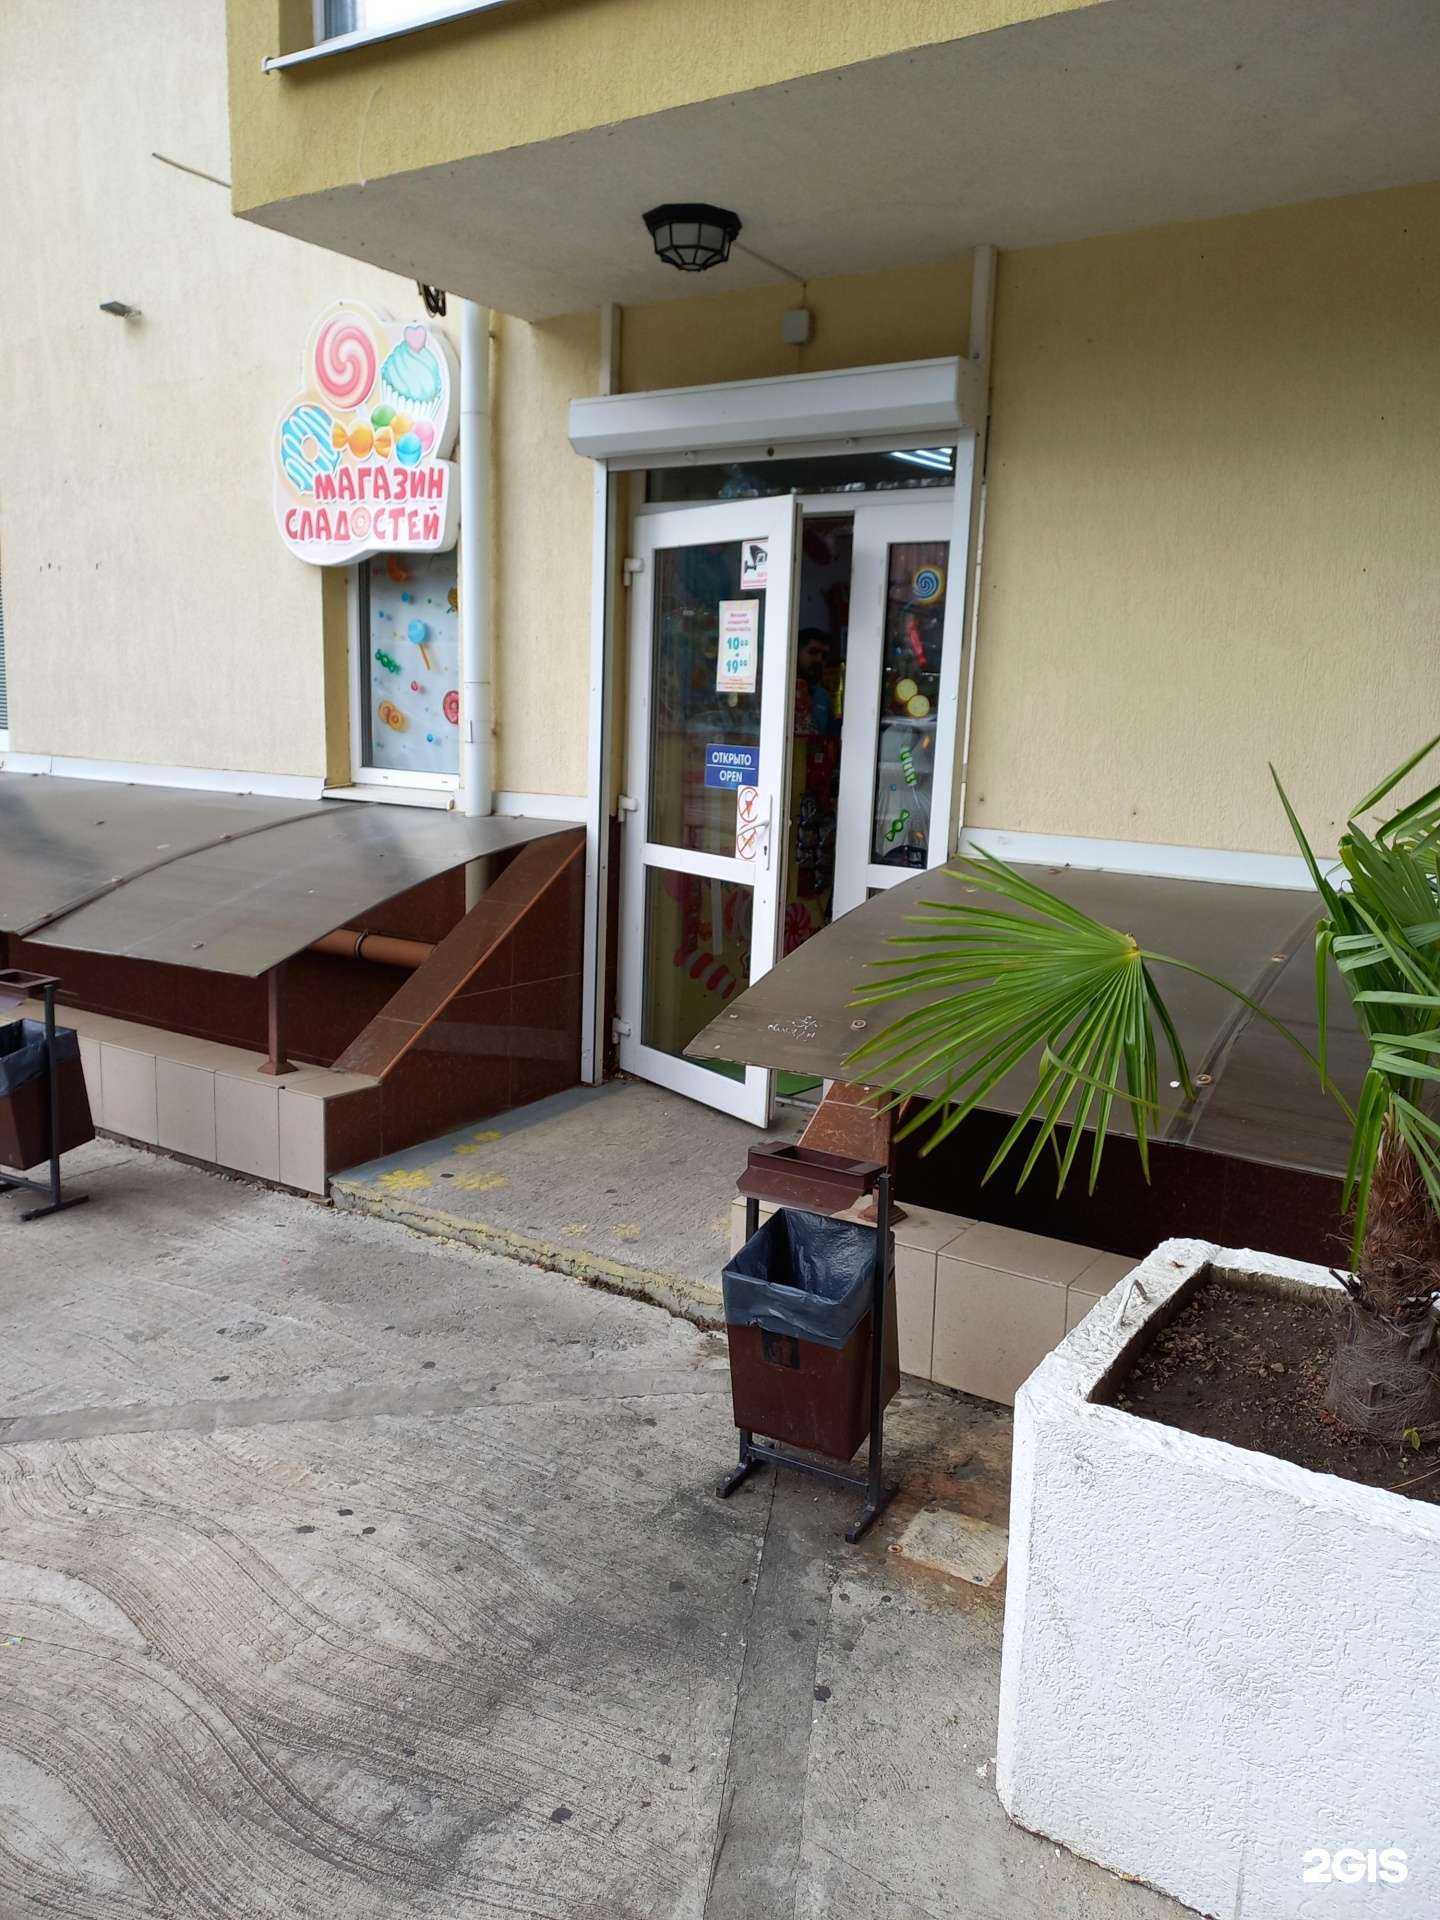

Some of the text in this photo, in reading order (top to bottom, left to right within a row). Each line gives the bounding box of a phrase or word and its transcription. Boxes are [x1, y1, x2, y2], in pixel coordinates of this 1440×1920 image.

[314, 465, 444, 501] МАГАЗИН
[284, 505, 440, 541] СЛАДОСТЕЙ
[711, 751, 752, 766] ОТКРЫТО
[719, 769, 743, 783] OPEN
